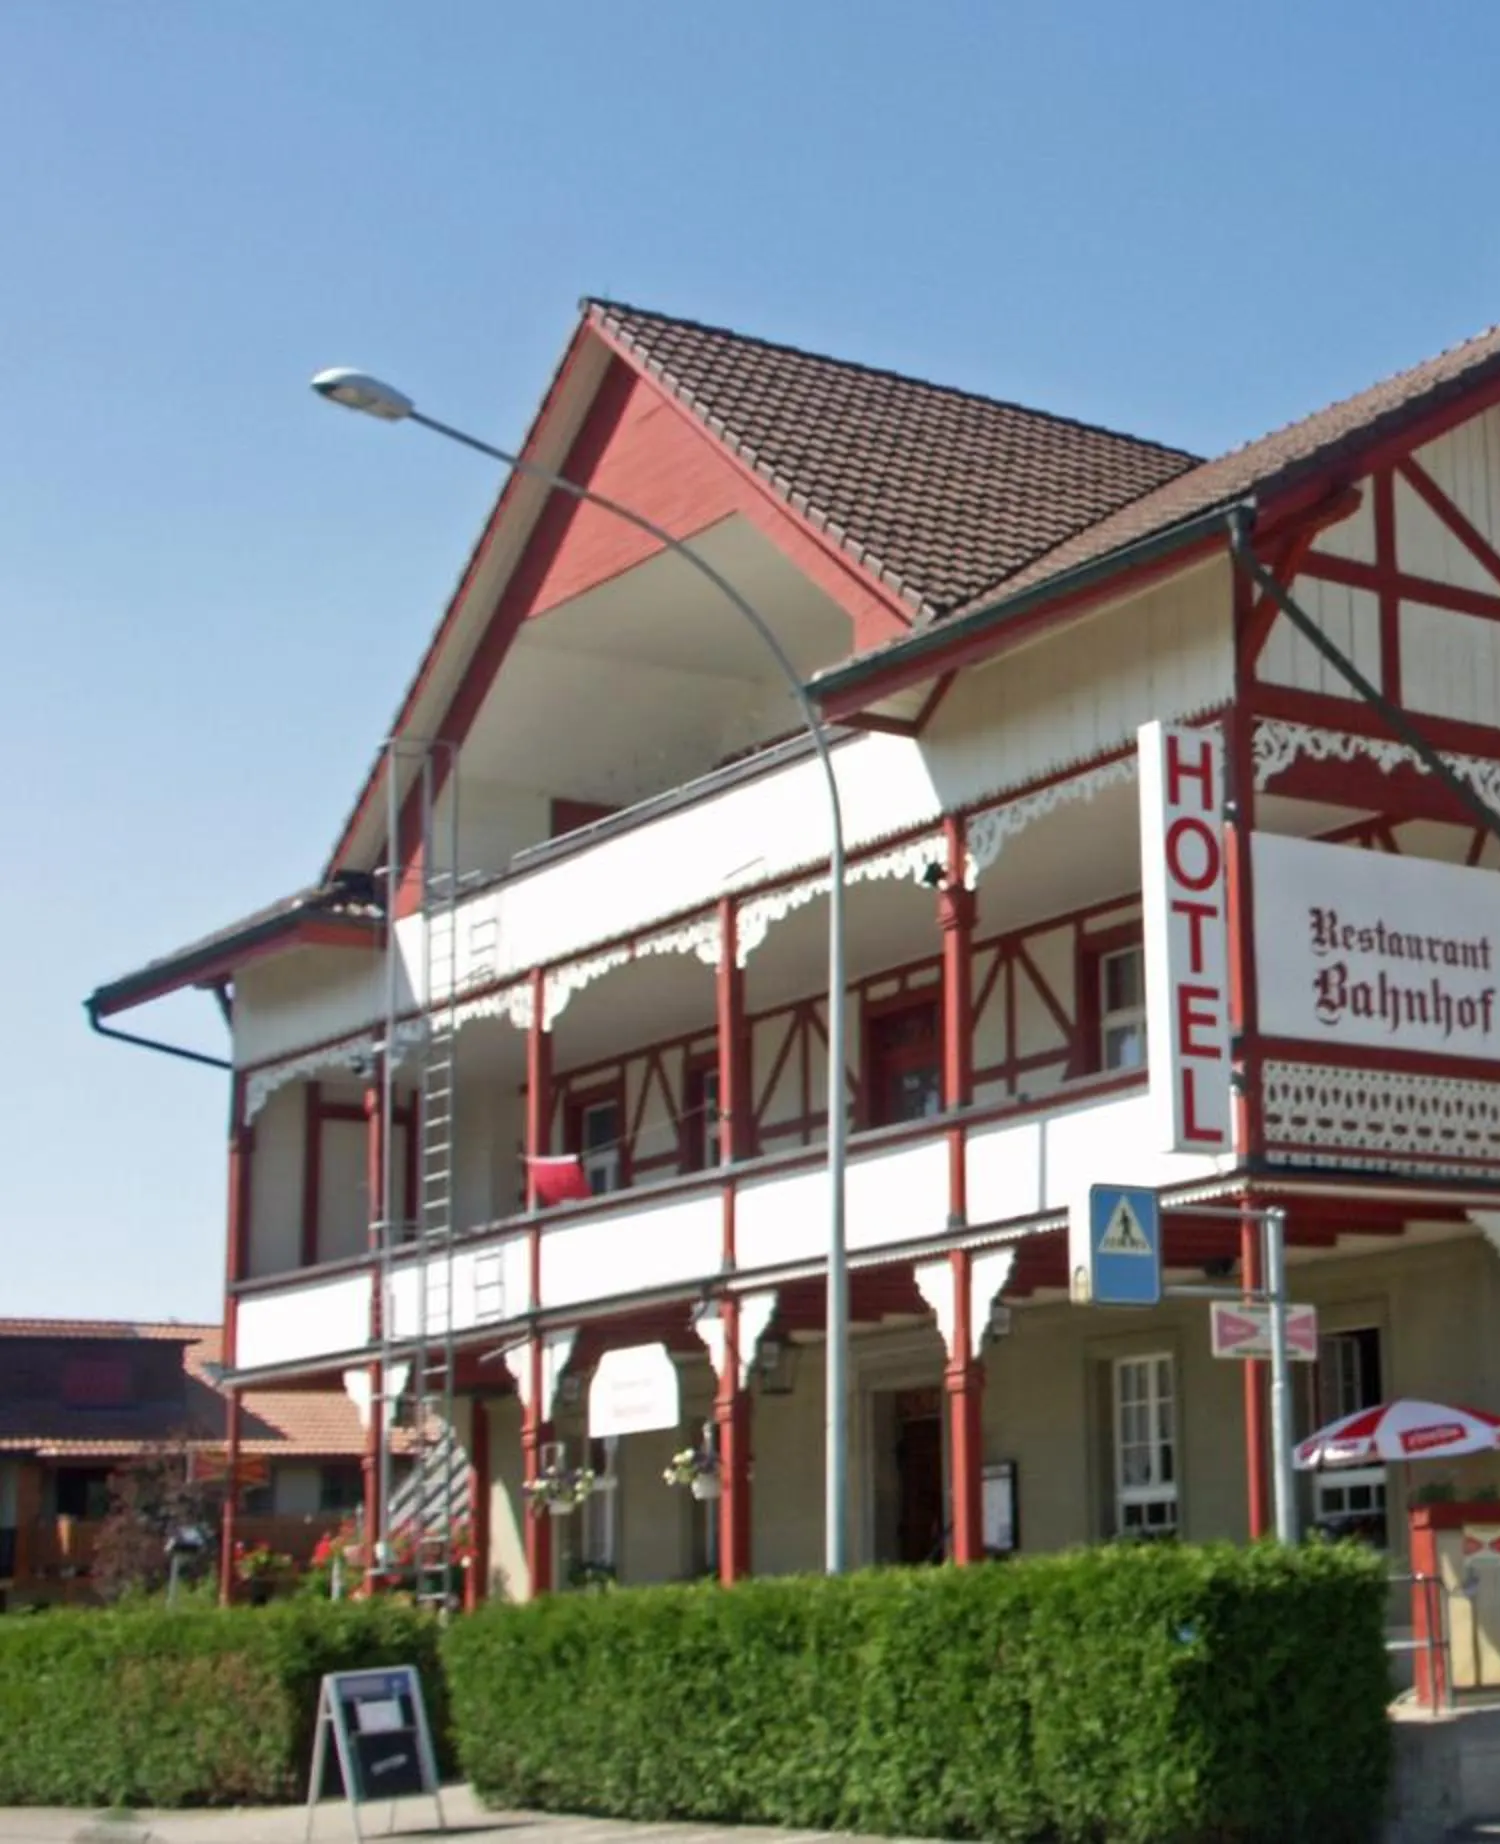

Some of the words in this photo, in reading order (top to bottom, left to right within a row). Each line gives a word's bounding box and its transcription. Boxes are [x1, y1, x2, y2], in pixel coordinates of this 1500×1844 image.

[1165, 735, 1223, 1143] HOTEL
[1308, 907, 1492, 971] Restaurant
[1312, 961, 1496, 1034] Bahnhof
